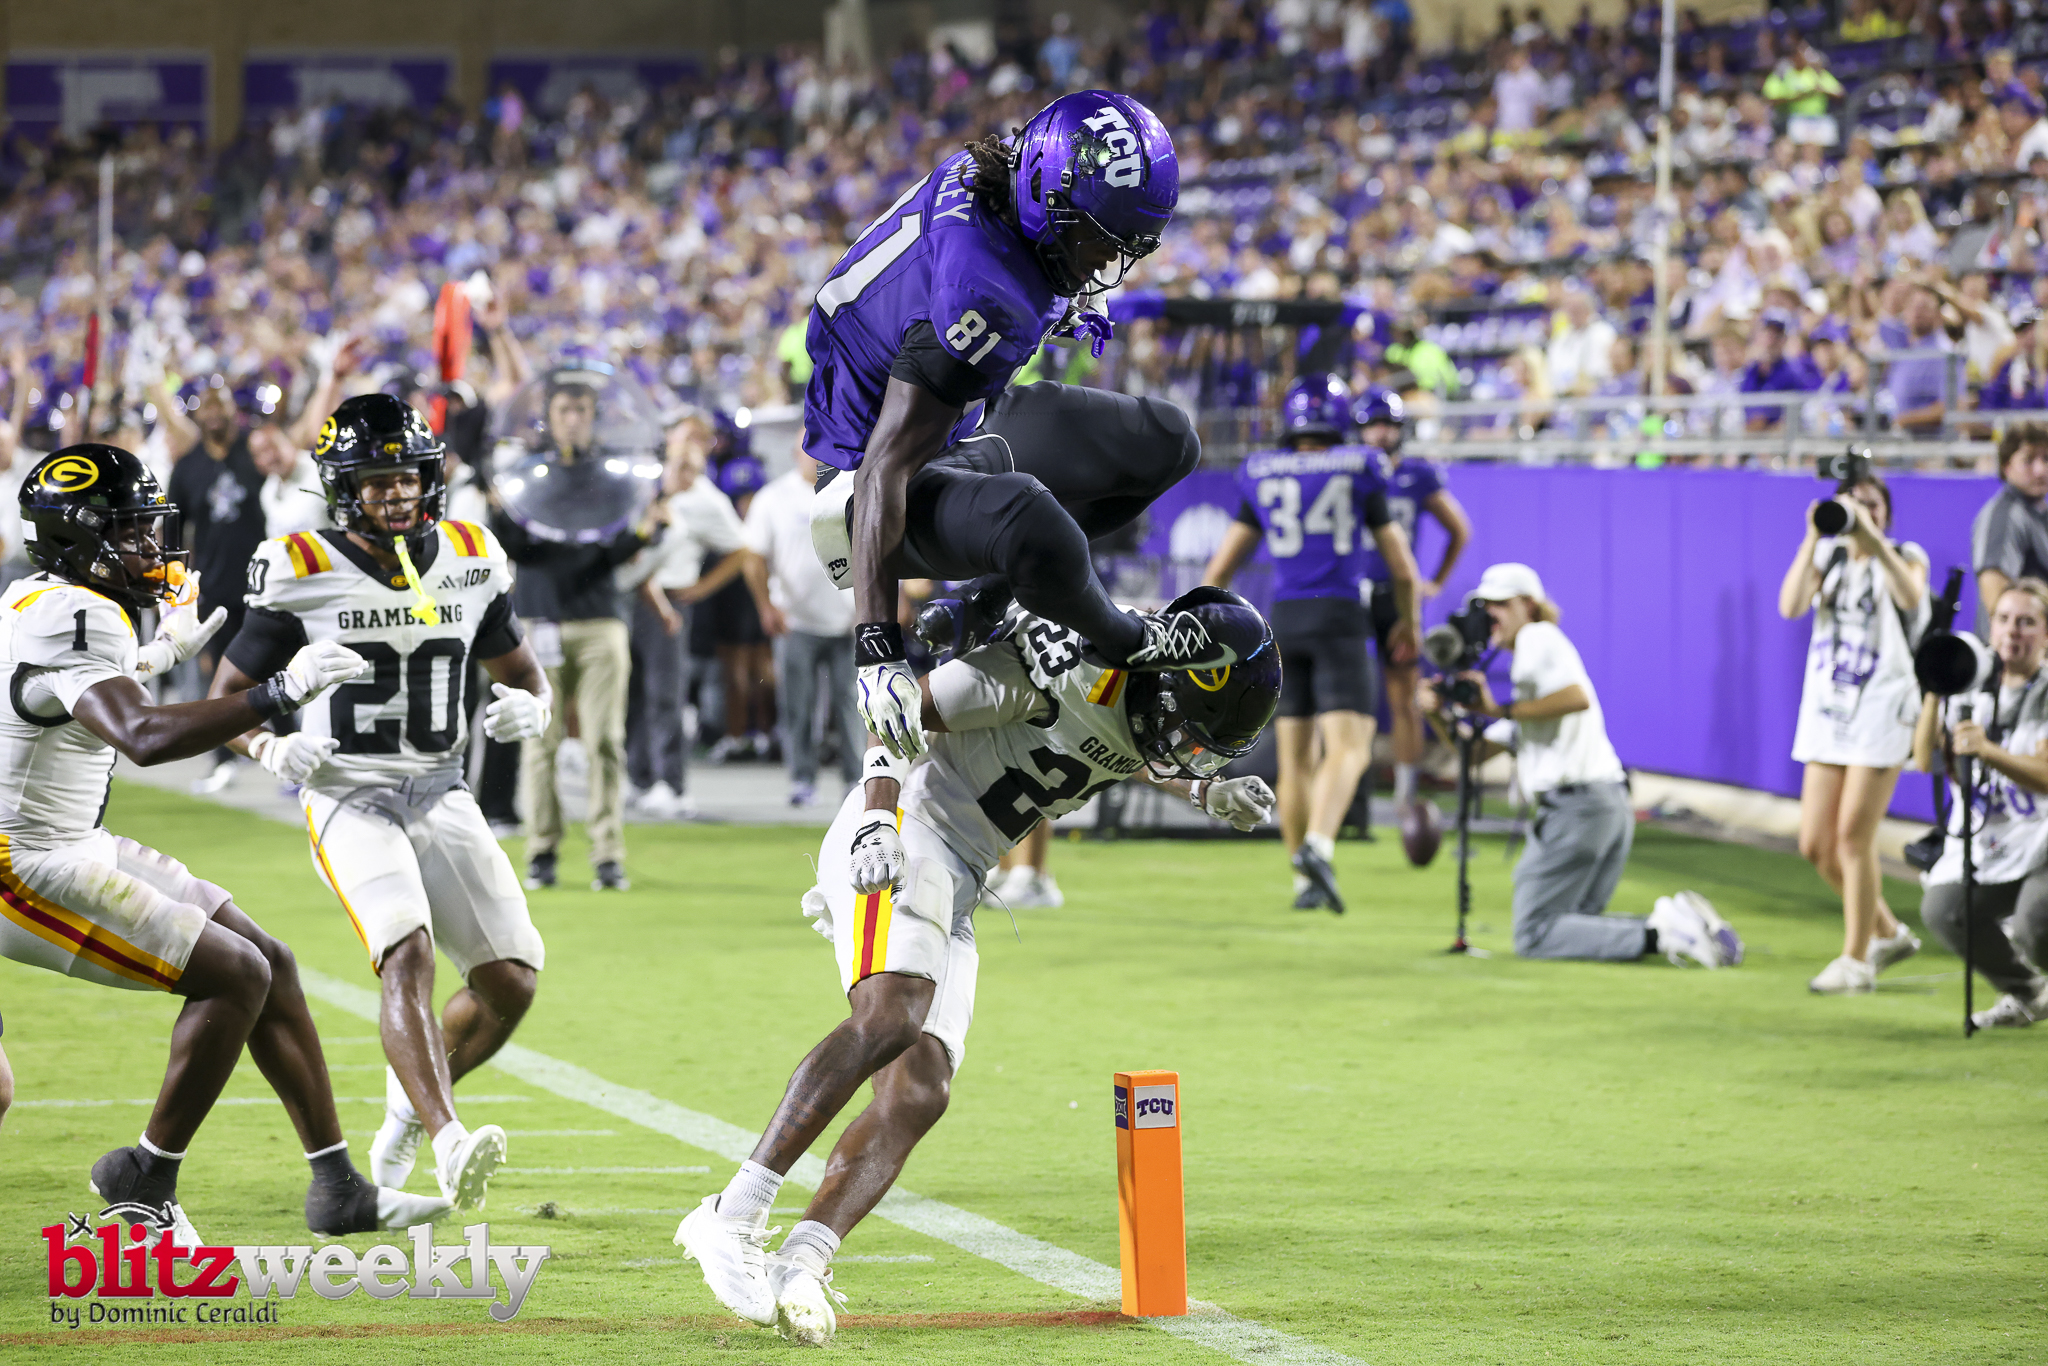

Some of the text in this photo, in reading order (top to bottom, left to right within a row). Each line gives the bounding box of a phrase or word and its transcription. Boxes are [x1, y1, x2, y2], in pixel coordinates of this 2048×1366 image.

[1082, 106, 1141, 188] TCU
[945, 309, 1002, 366] 81
[1257, 474, 1356, 558] 34
[828, 558, 848, 572] TCU
[73, 609, 88, 650] 1
[338, 604, 463, 629] GRAMBNG
[1028, 622, 1080, 678] 23
[330, 638, 466, 755] 20
[1137, 1098, 1173, 1117] TCU
